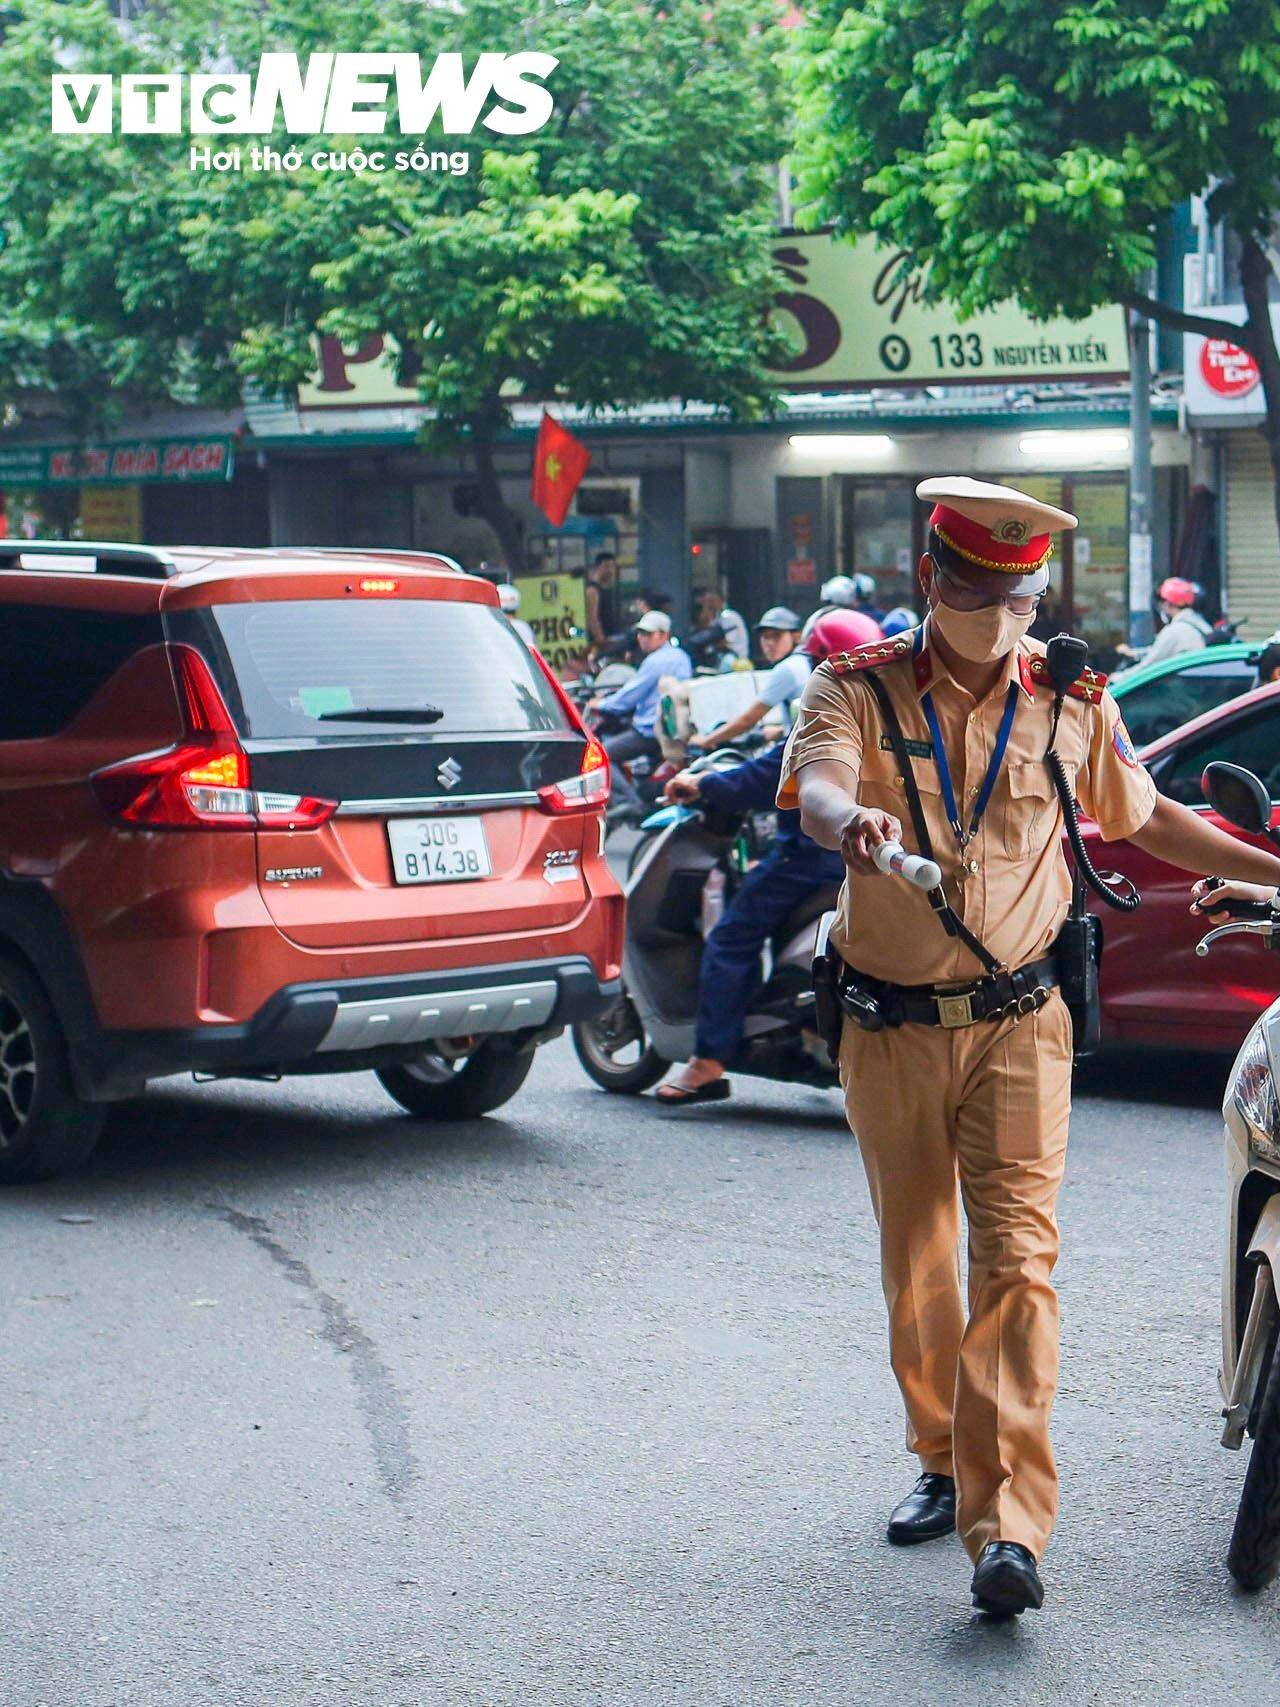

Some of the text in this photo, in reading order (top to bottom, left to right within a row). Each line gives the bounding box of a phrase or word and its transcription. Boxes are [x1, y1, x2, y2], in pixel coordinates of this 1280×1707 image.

[930, 333, 983, 368] 133
[418, 822, 458, 847] 30G
[265, 866, 323, 881] SUZUKI
[405, 849, 480, 877] 814.38
